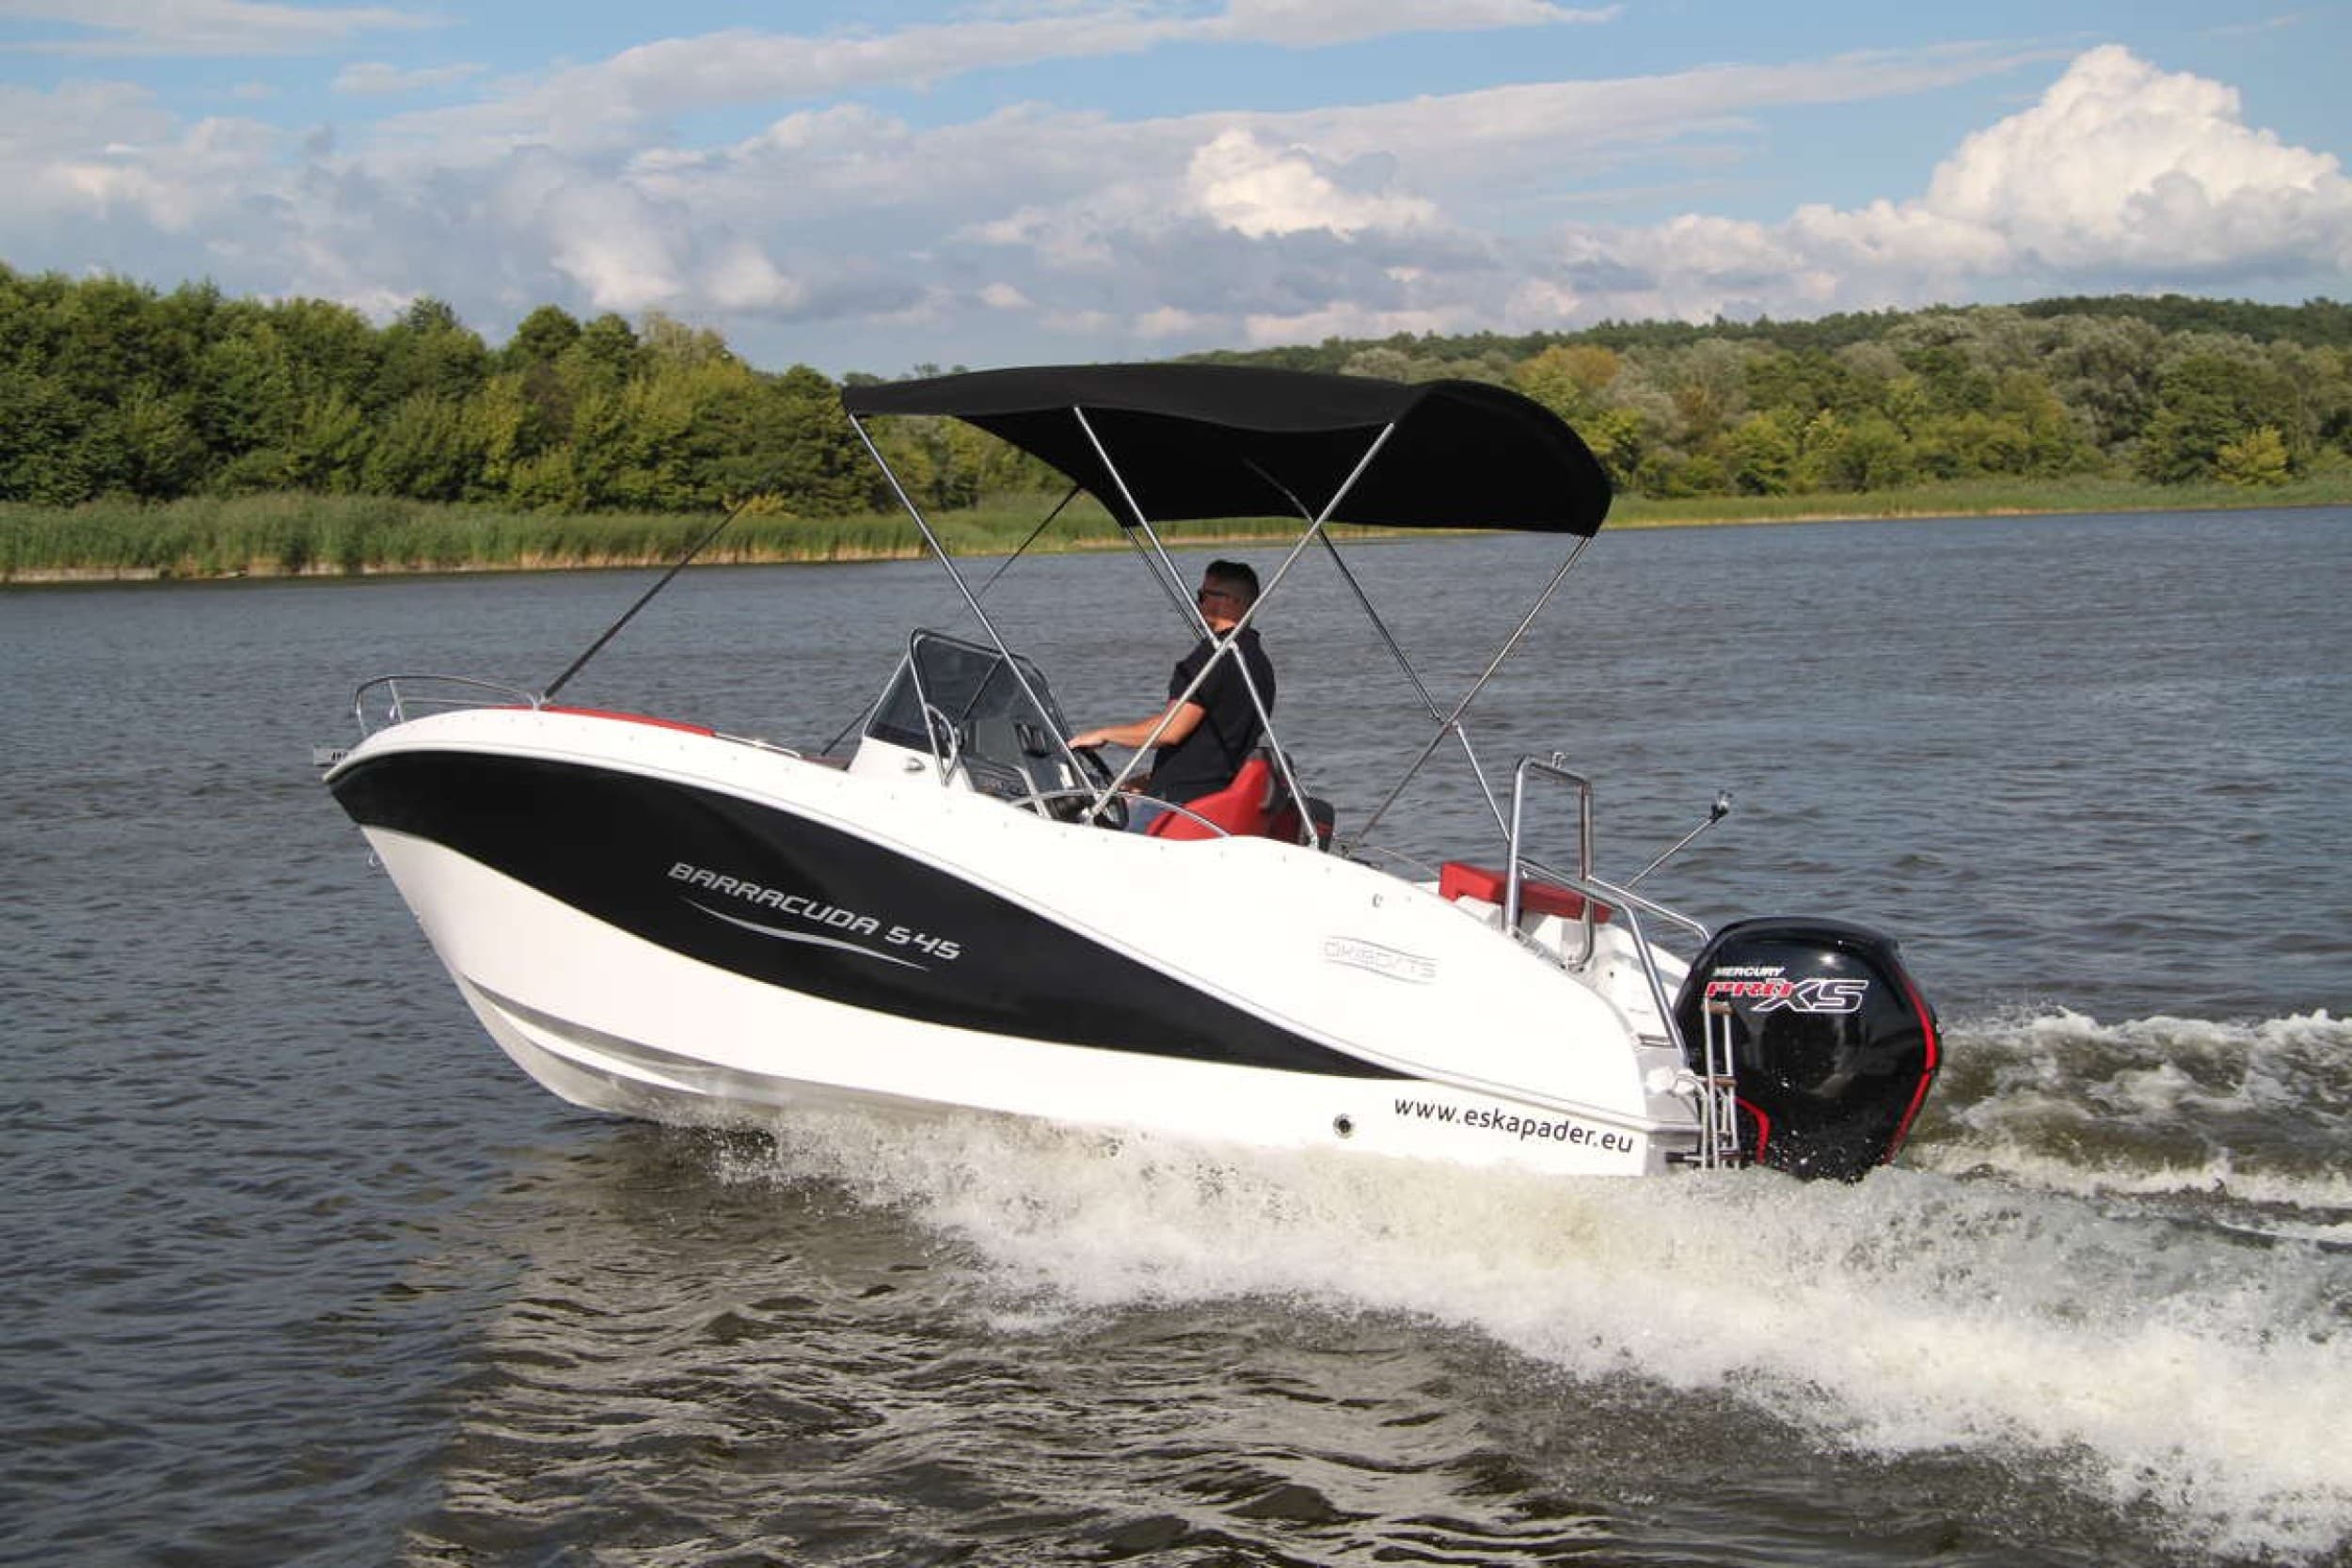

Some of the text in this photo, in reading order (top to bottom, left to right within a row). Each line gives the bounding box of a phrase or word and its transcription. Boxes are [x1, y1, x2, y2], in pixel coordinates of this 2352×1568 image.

[668, 862, 961, 960] BARRACUDA 545
[1713, 966, 1786, 977] MERCURY
[1394, 1098, 1633, 1153] www.eskapader.eu
